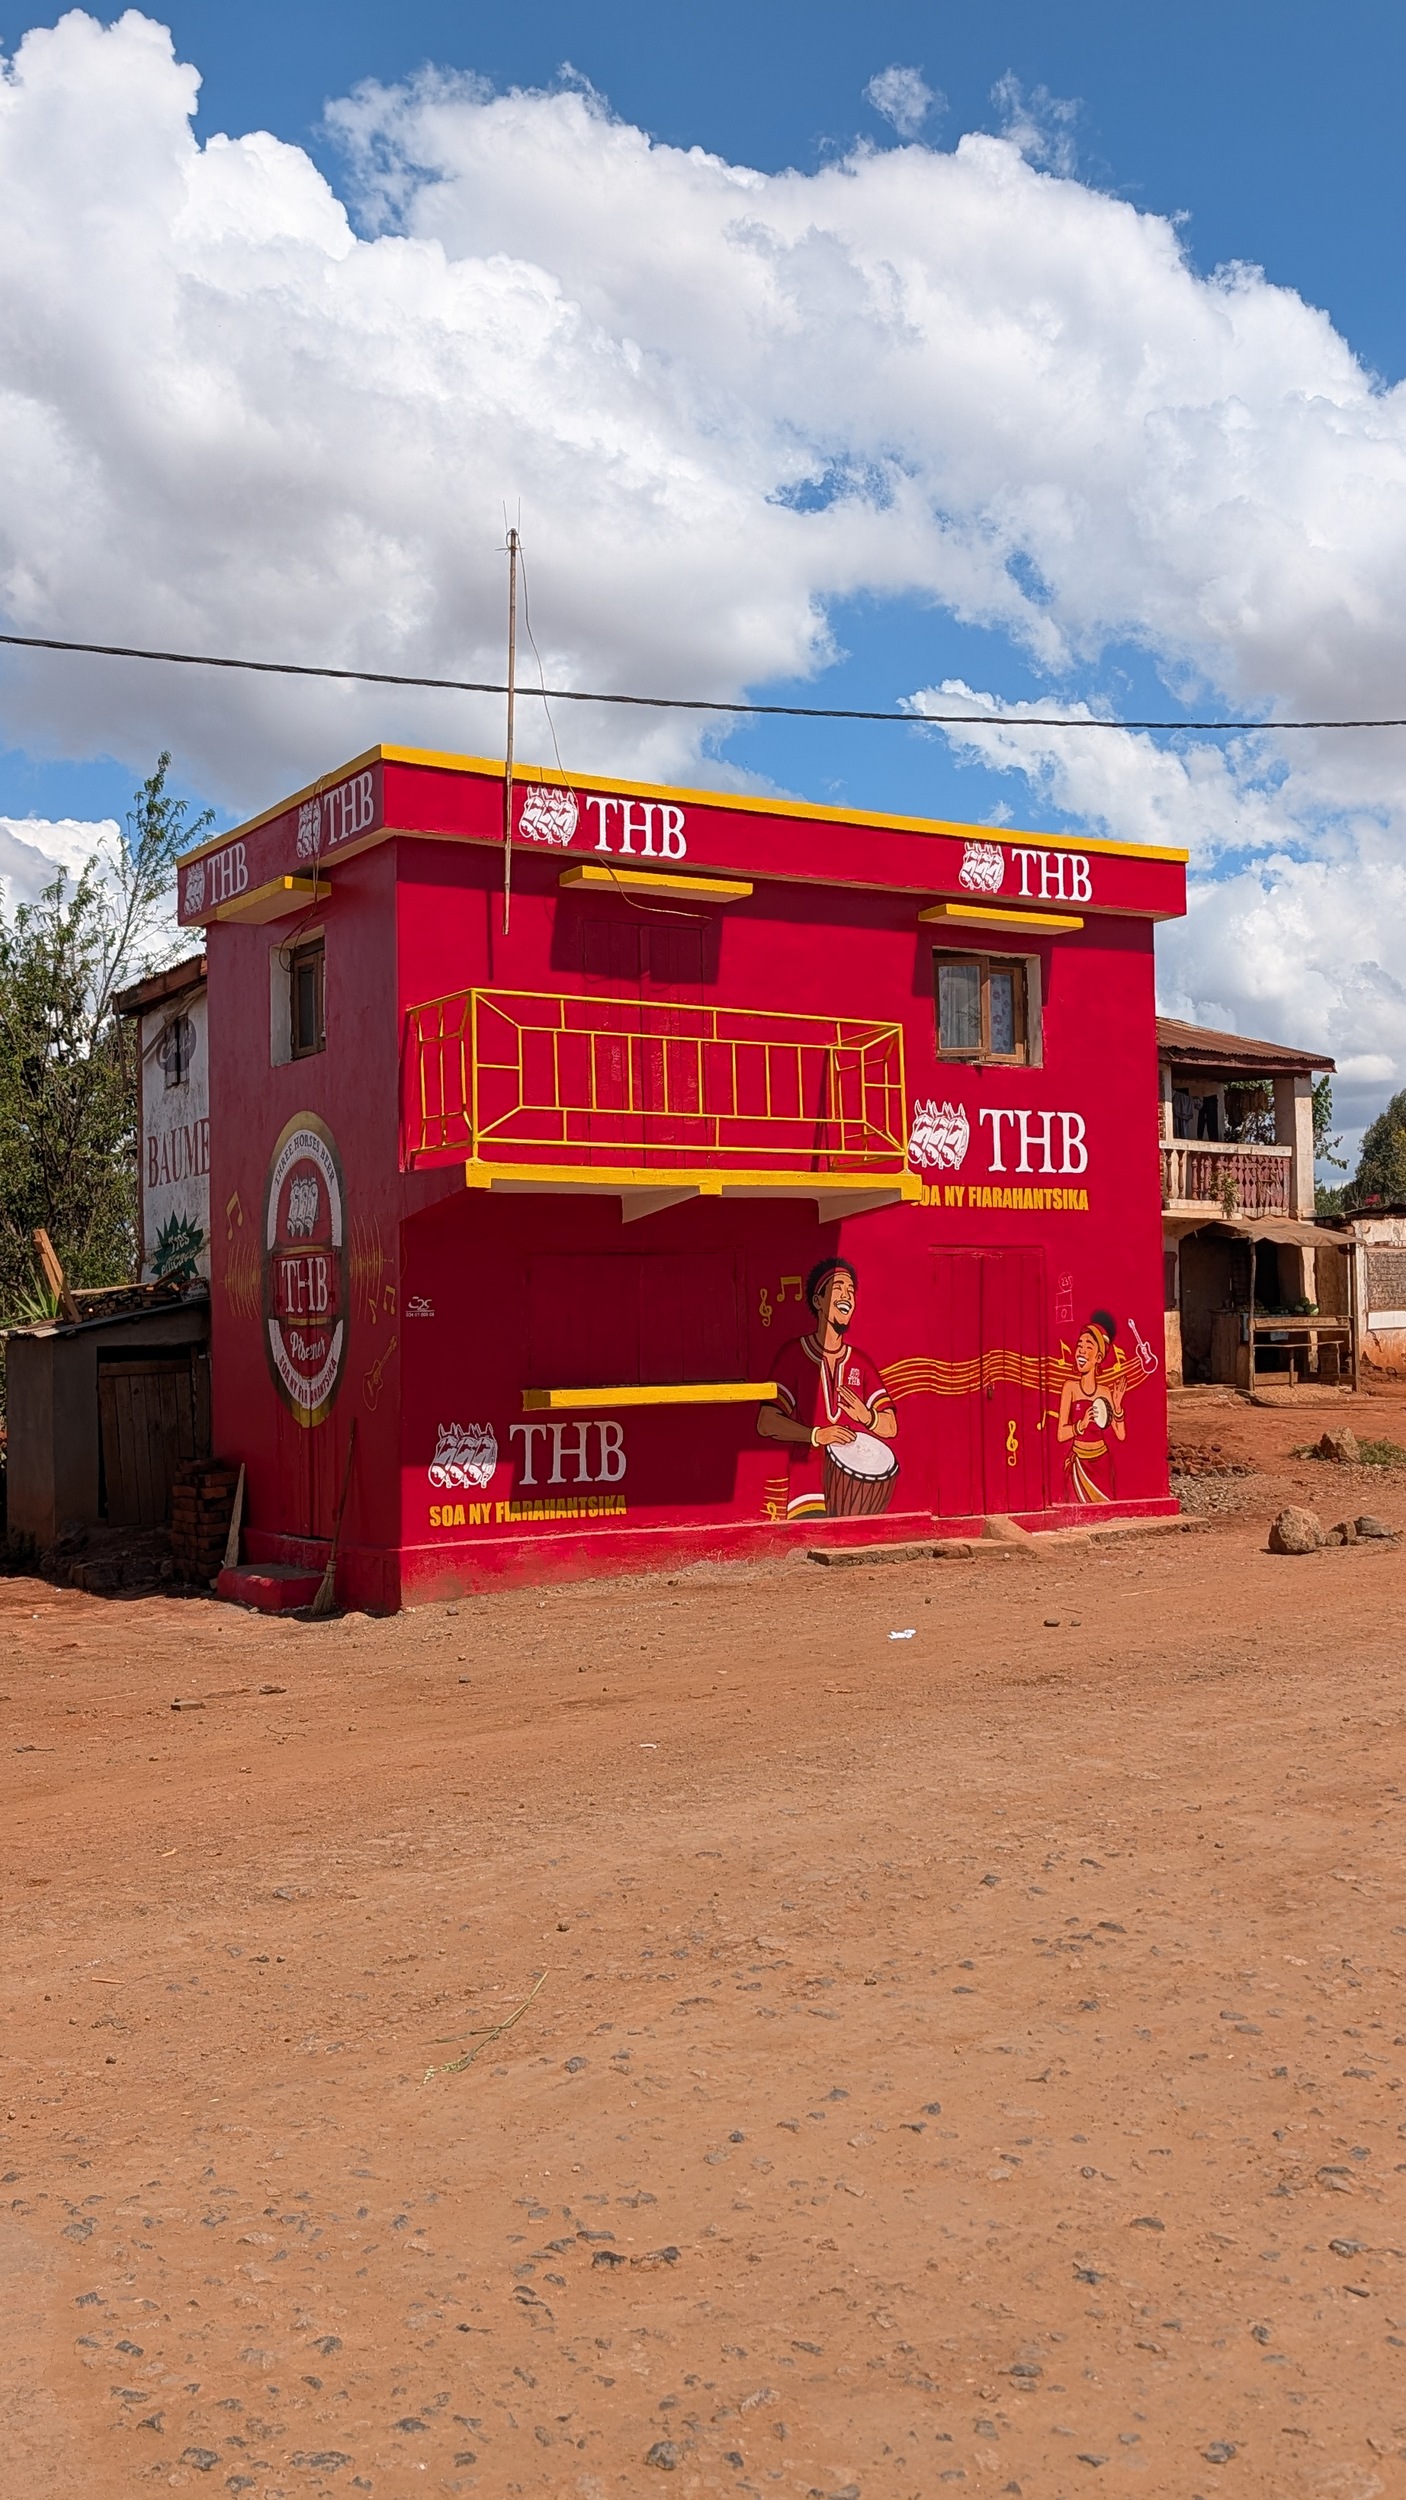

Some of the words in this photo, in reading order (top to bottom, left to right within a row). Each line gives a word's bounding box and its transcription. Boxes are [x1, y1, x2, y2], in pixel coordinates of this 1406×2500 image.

[322, 770, 375, 847] THB
[586, 795, 688, 860] THB
[205, 841, 250, 906] THB
[1011, 848, 1093, 902] THB
[274, 1144, 294, 1185] THREE
[294, 1134, 320, 1153] HORSES
[320, 1147, 335, 1185] BEER
[979, 1108, 1089, 1174] THB
[944, 1185, 966, 1207] NY
[968, 1186, 1090, 1211] FIARAHANTSIKA
[281, 1256, 328, 1313] THB
[509, 1420, 627, 1485] THB
[429, 1504, 465, 1527] SOA
[469, 1502, 491, 1526] NY
[495, 1494, 628, 1525] FIARAHANTSIKA
